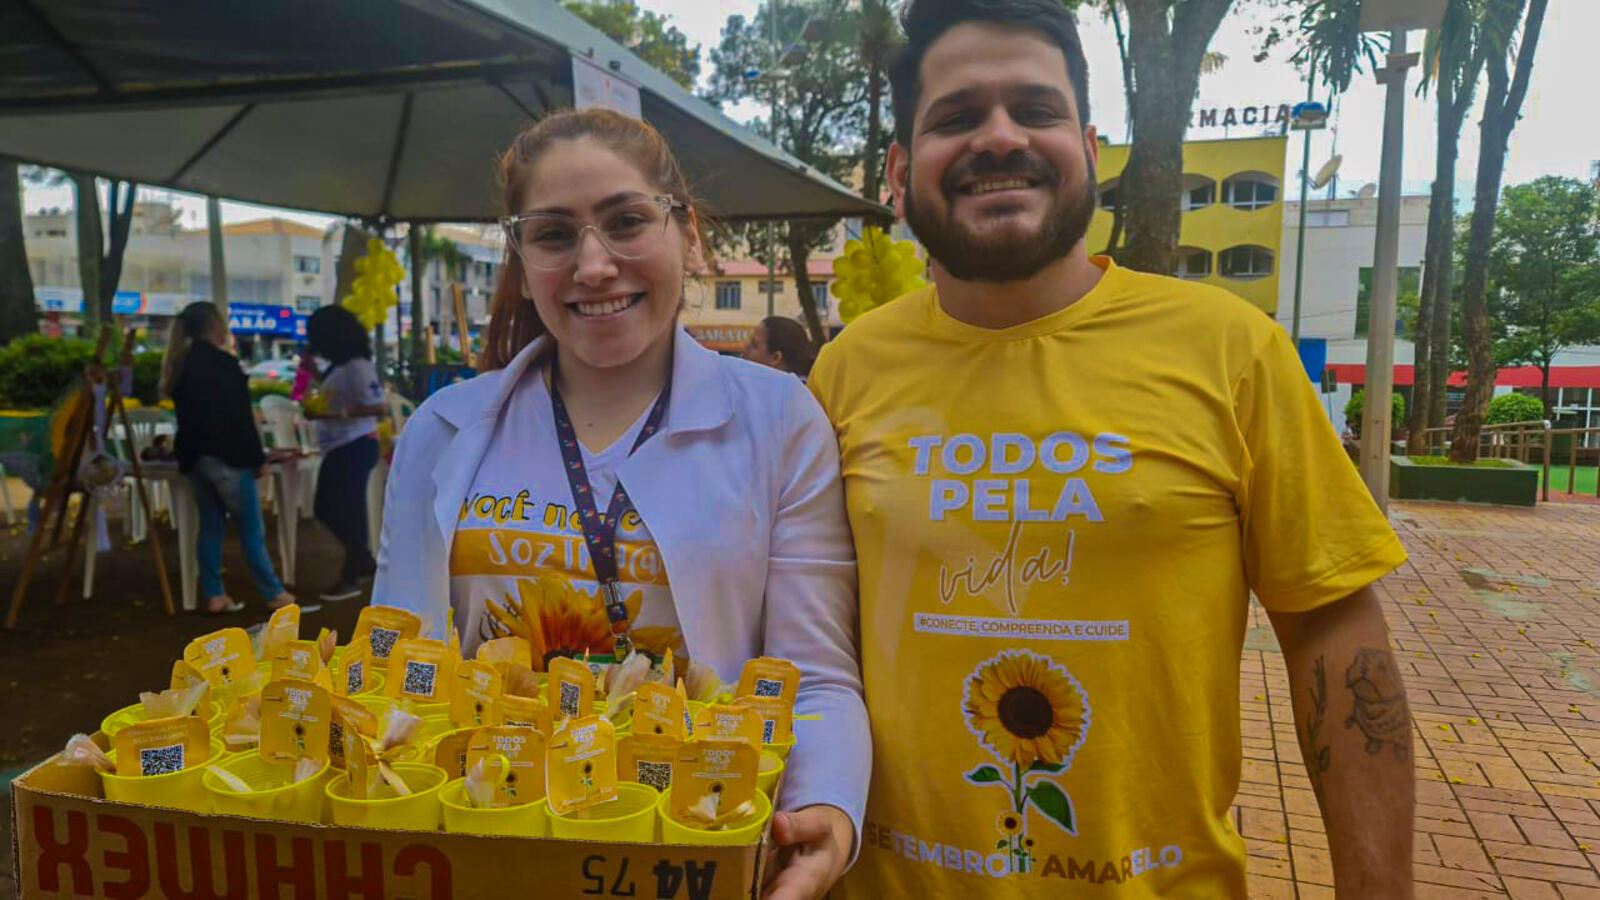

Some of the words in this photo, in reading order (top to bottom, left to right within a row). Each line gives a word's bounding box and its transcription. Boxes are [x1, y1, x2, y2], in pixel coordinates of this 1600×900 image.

[908, 430, 1134, 475] TODOS
[459, 489, 535, 525] VOCÊ
[930, 477, 1105, 522] PELA
[939, 519, 1076, 615] vida!
[1075, 624, 1083, 636] E
[868, 823, 1010, 878] SETEMBRO
[1040, 845, 1183, 885] AMARELO
[582, 855, 636, 897] 75
[653, 859, 717, 900] A4
